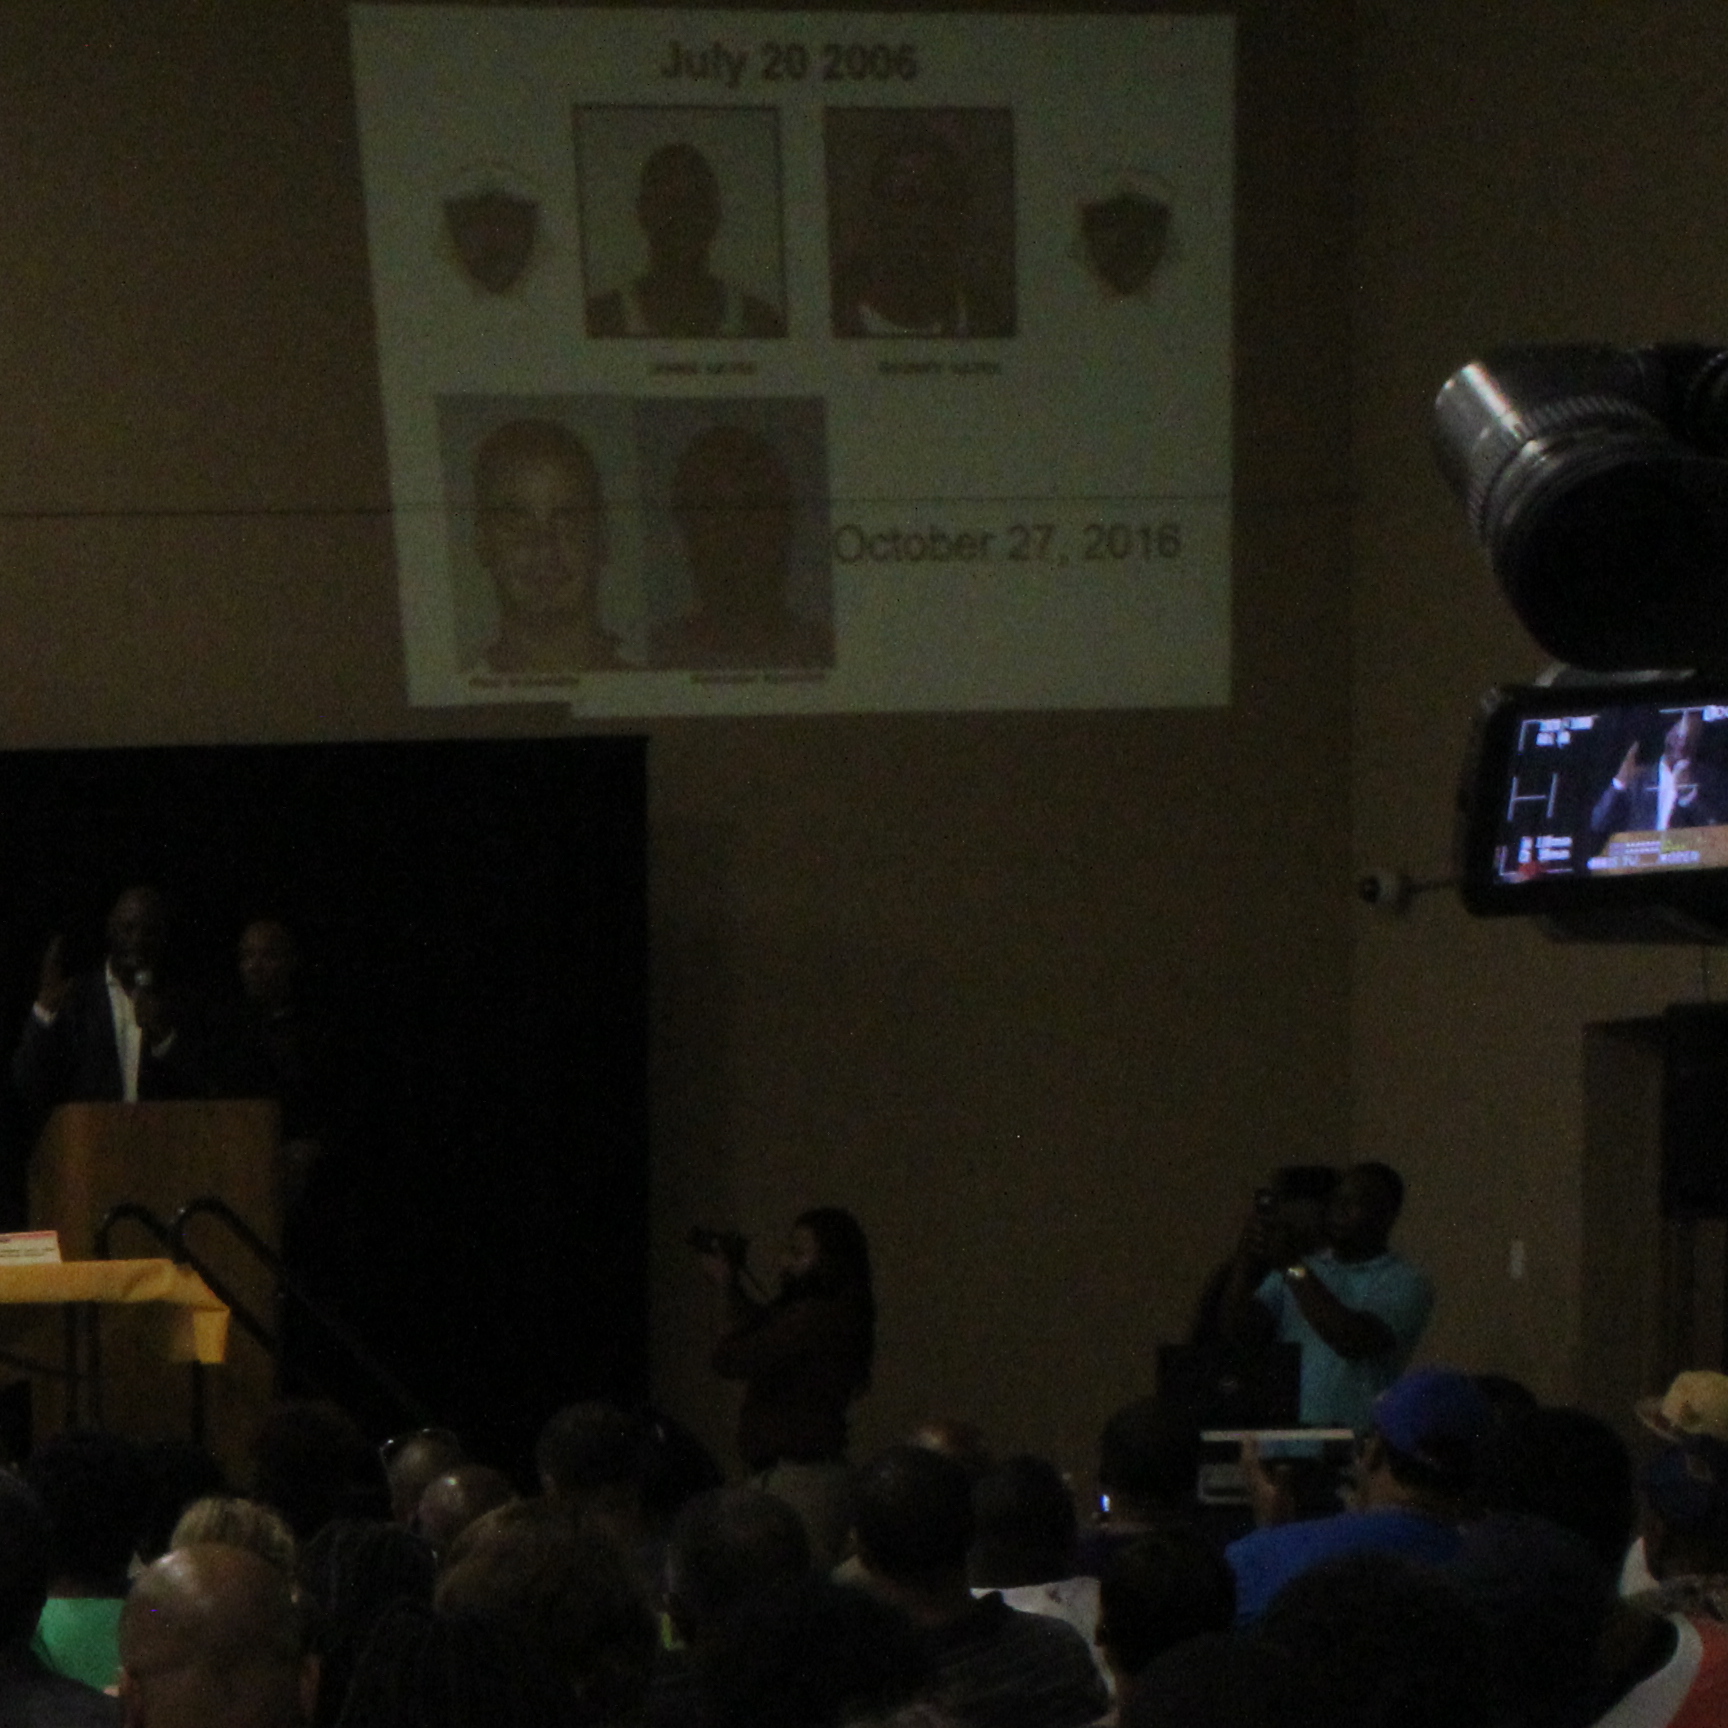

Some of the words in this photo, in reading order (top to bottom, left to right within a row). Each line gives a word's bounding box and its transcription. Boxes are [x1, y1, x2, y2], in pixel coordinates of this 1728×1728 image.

[661, 40, 748, 88] July
[761, 42, 810, 81] 20
[833, 524, 994, 563] October
